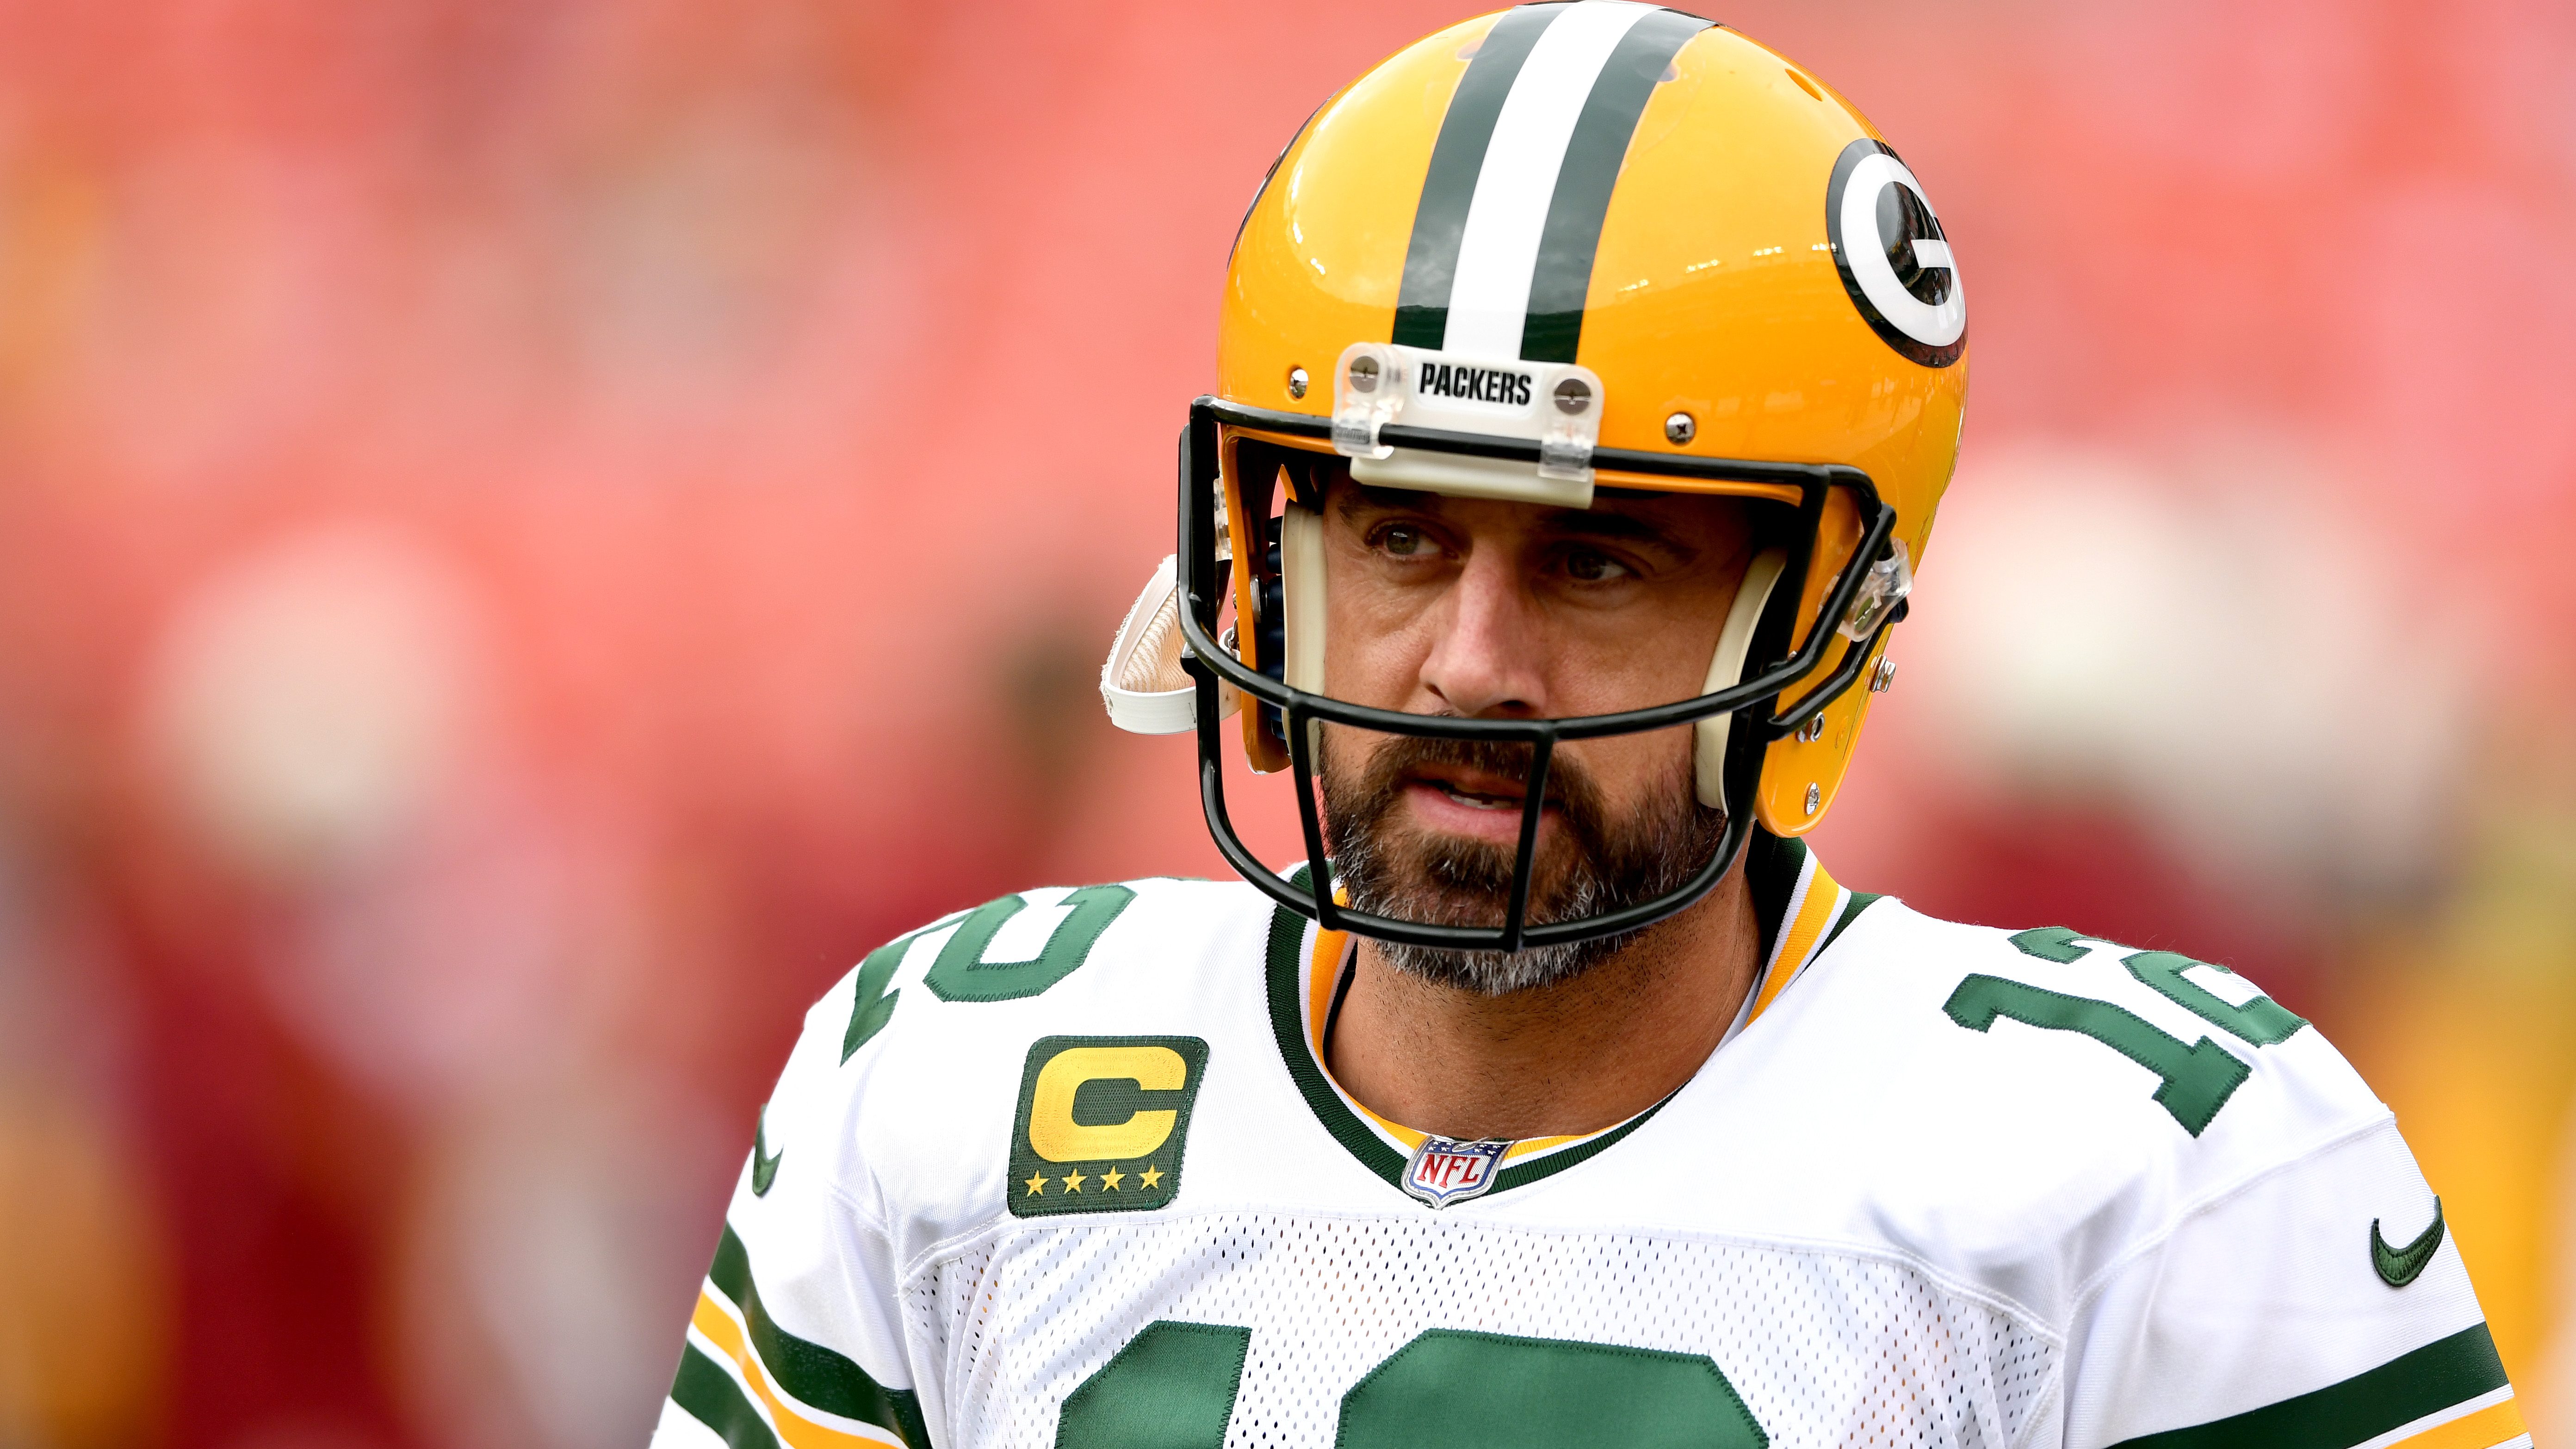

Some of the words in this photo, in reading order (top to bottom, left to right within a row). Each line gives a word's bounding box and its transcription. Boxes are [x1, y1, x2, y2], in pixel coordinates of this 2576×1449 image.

[1840, 153, 1966, 347] G
[1419, 363, 1531, 406] PACKERS
[1029, 1046, 1187, 1163] C
[1417, 1154, 1480, 1189] NFL
